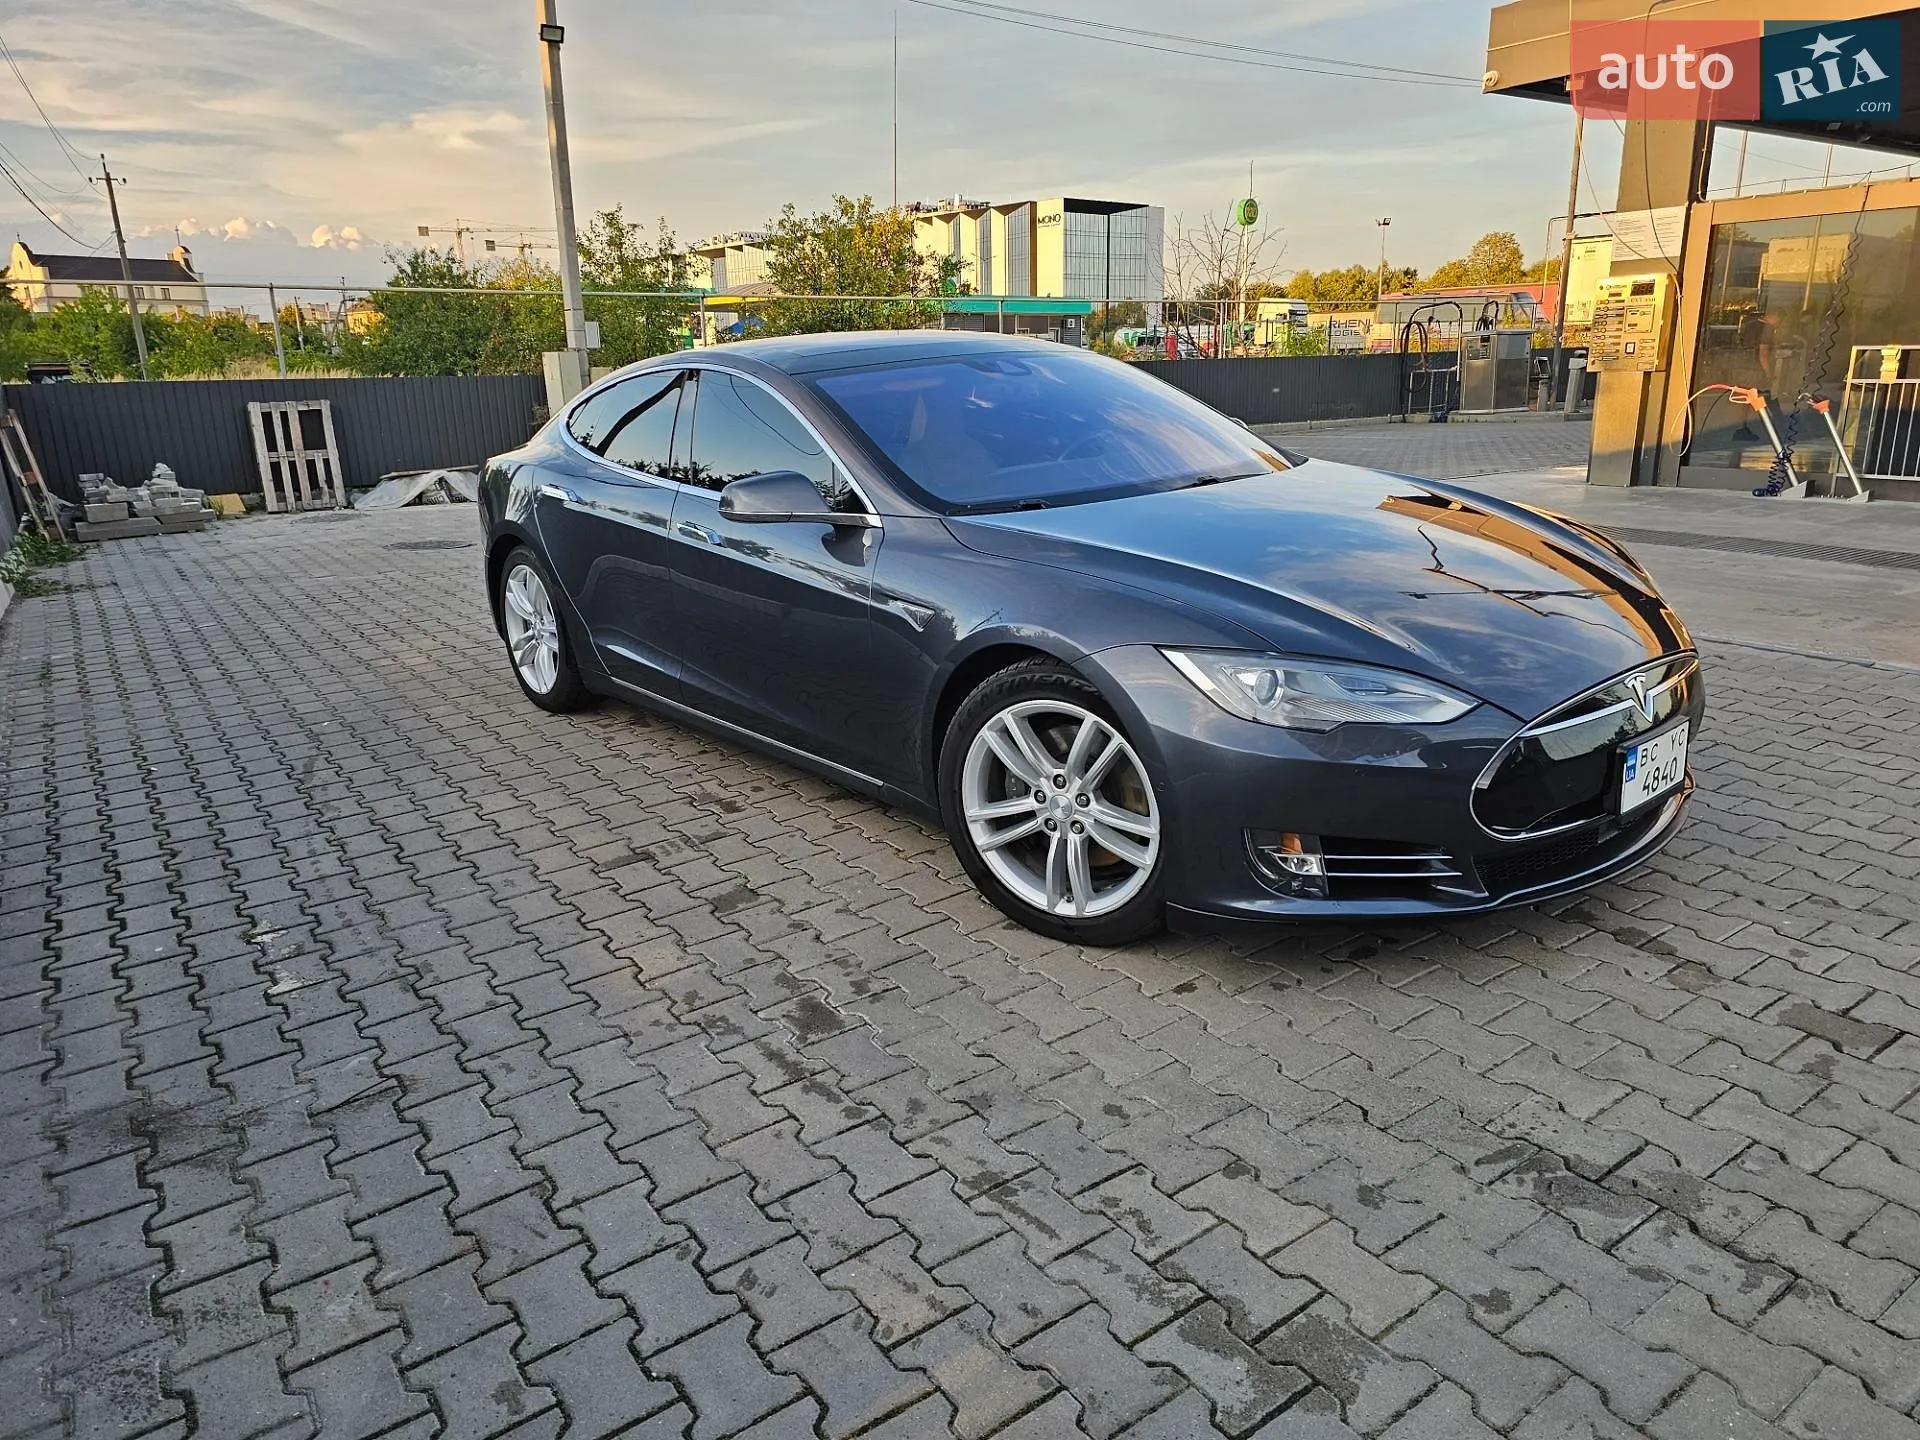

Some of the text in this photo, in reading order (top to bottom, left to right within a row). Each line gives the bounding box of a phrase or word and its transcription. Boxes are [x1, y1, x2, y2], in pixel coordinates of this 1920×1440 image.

[1038, 213, 1061, 225] MONO
[1640, 728, 1685, 768] BC YC
[1625, 768, 1635, 781] UA
[1642, 756, 1678, 797] 4840
